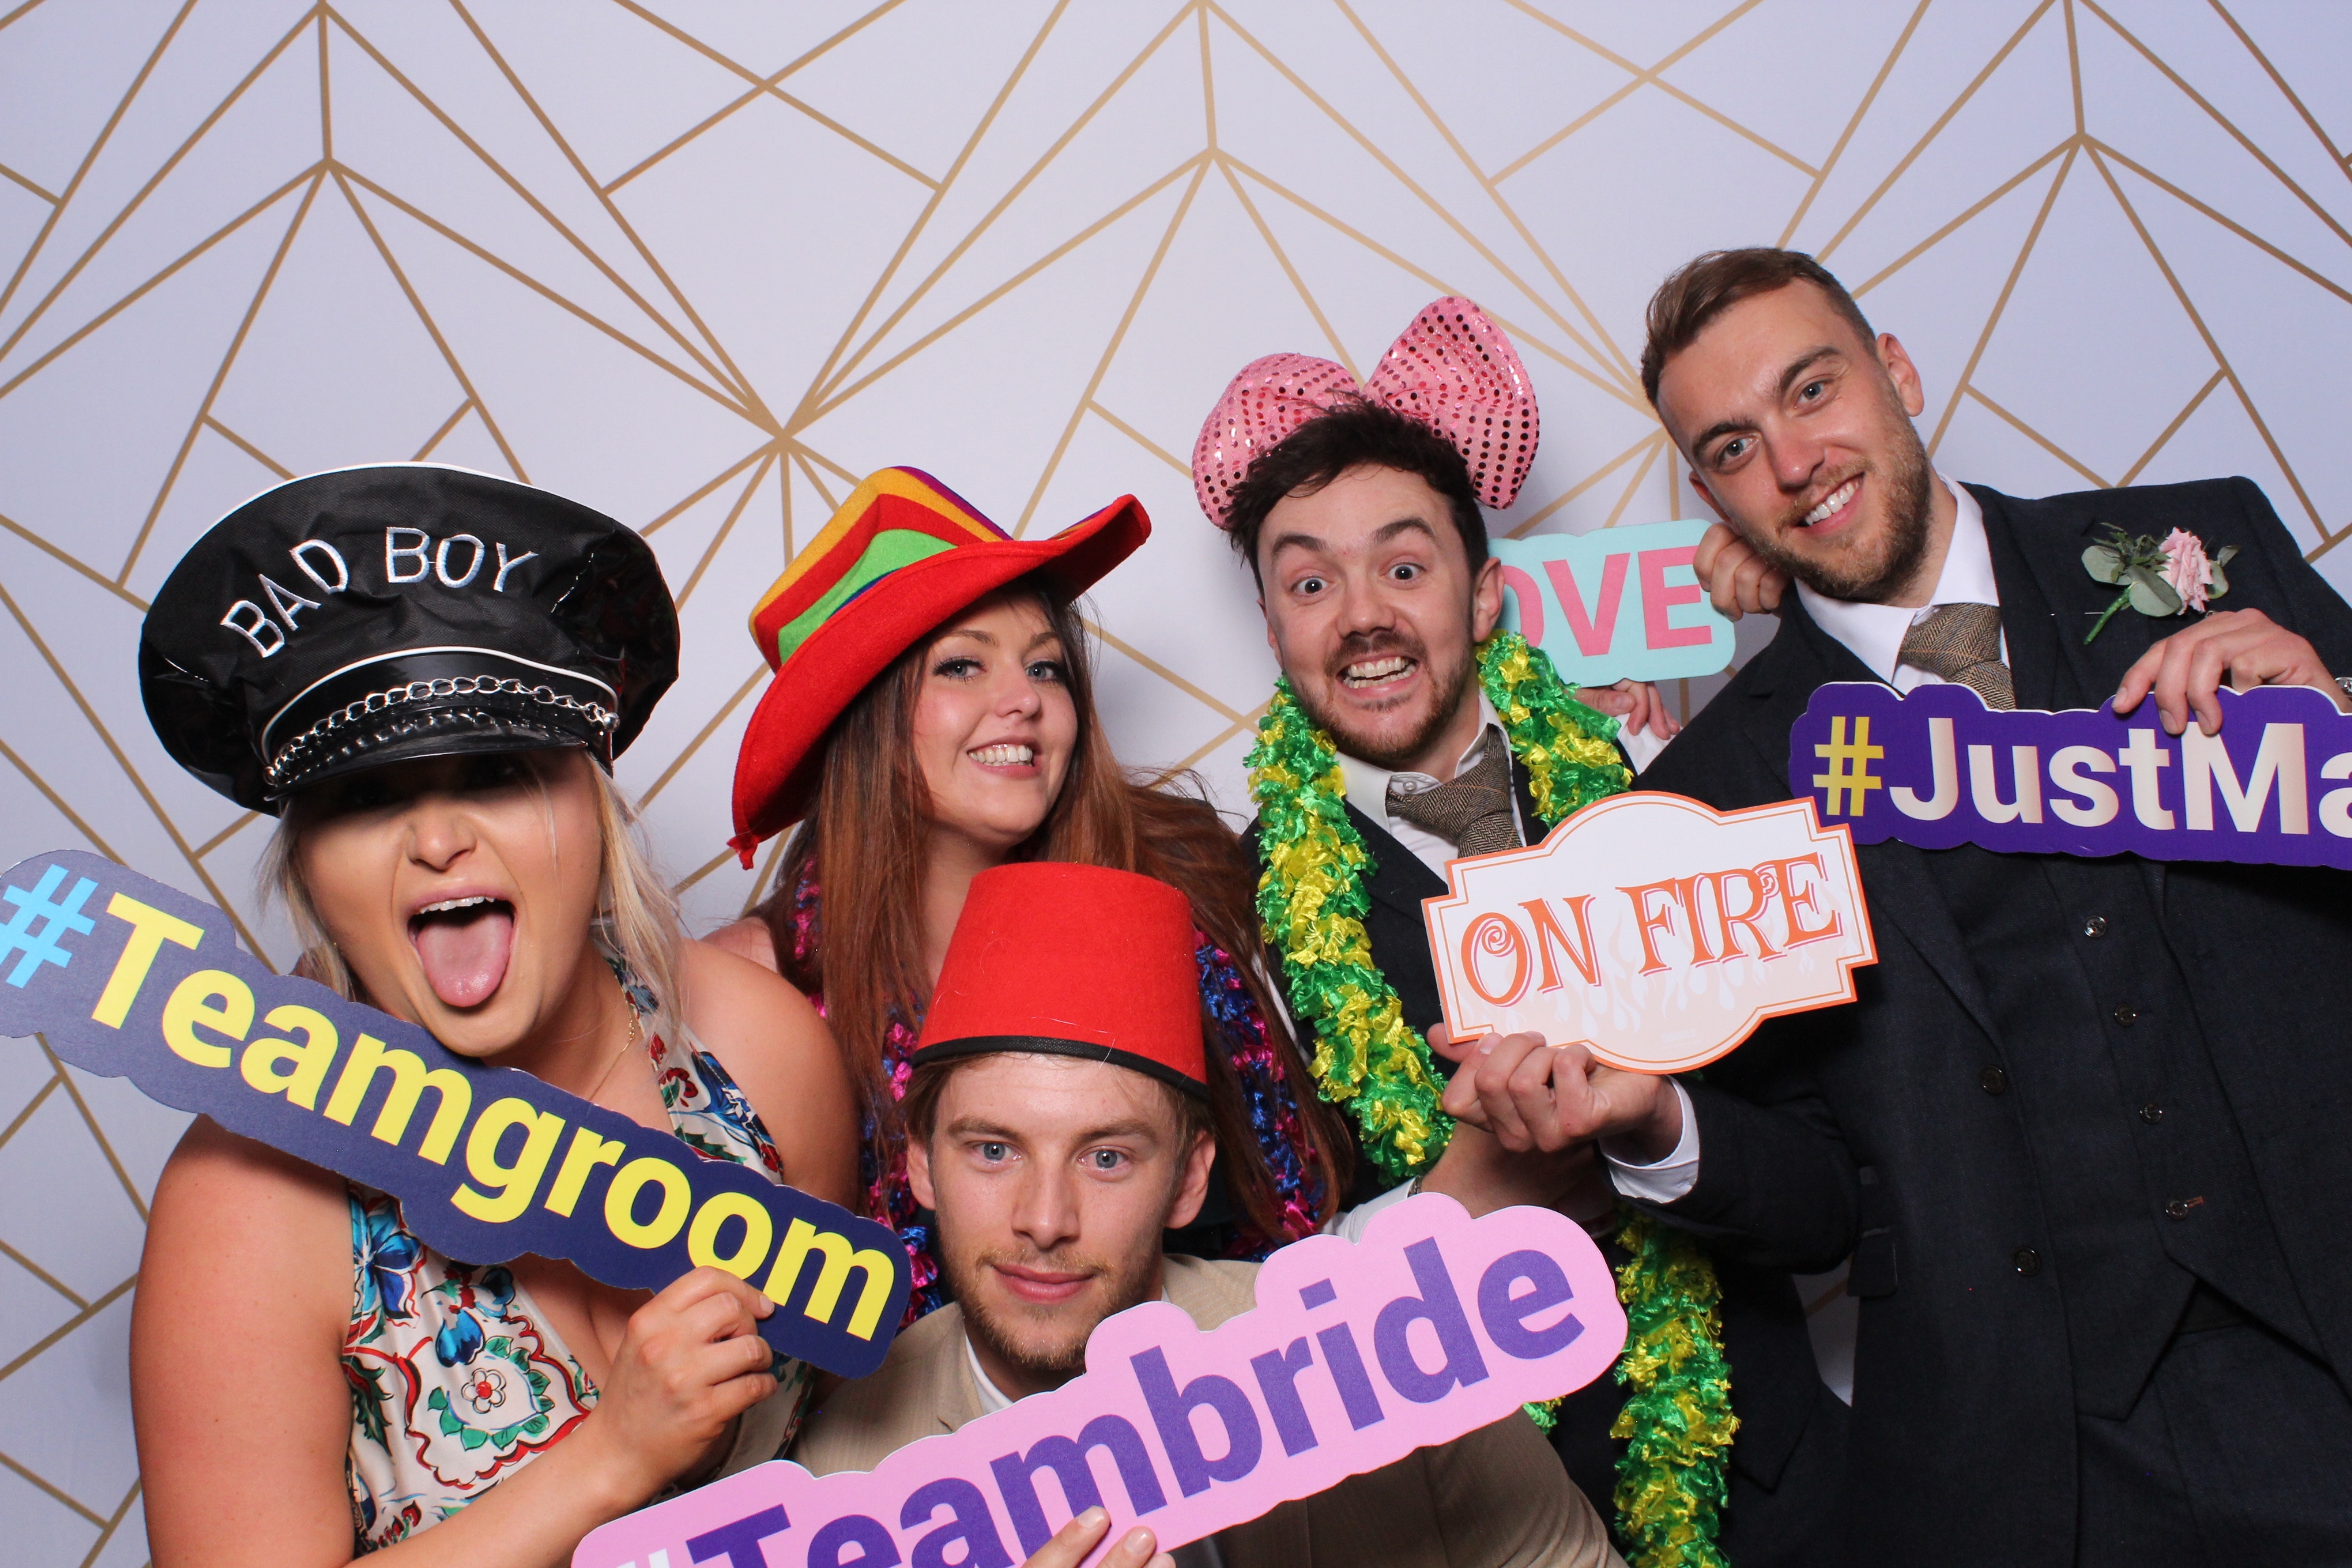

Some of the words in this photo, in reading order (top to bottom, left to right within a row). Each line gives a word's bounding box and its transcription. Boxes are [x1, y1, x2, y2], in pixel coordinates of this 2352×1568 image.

[220, 539, 348, 658] BAD
[386, 527, 538, 591] BOY
[1461, 894, 1602, 1007] ON
[1615, 852, 1844, 977] FIRE
[0, 864, 895, 1341] #Teamgroom
[616, 1237, 1586, 1568] Teambride
